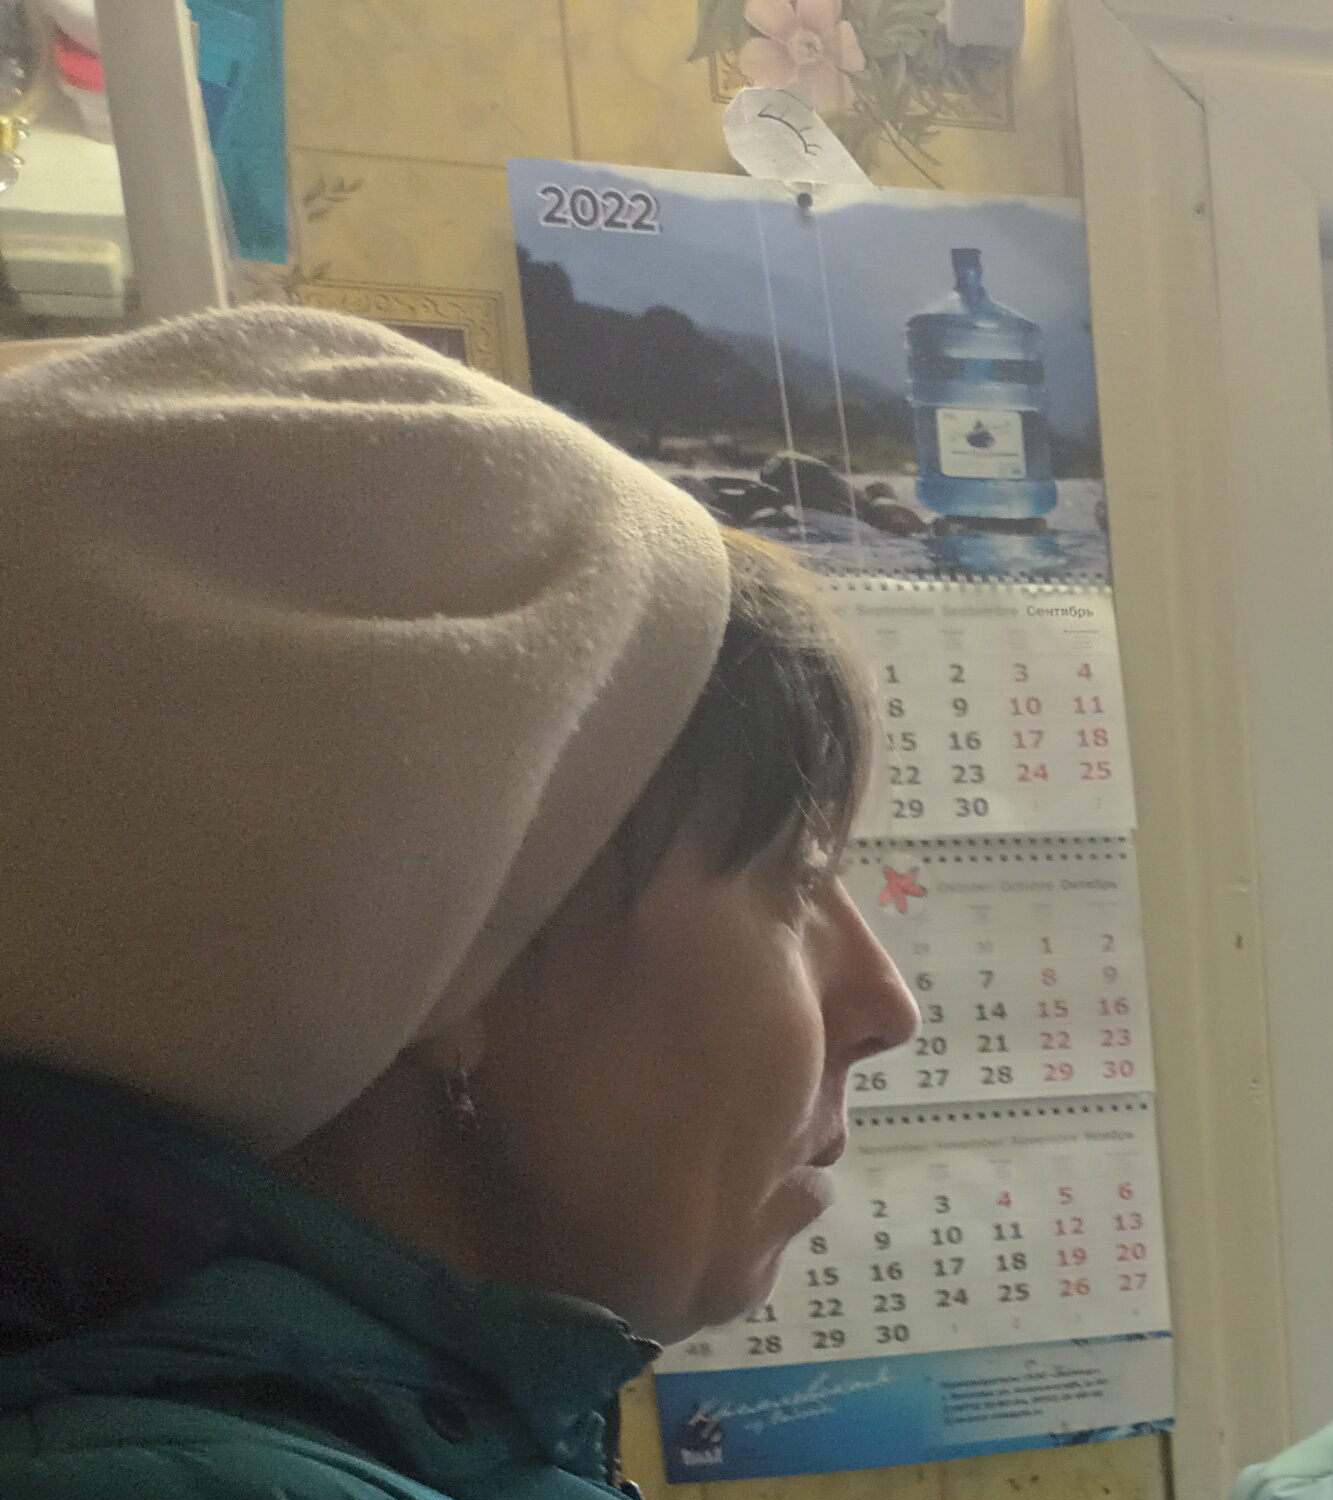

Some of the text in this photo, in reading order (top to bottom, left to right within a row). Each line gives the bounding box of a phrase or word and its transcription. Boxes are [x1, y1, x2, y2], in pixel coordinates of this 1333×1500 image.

[538, 184, 659, 232] 2022
[1026, 604, 1095, 618] Сентябрь
[885, 663, 1093, 684] 1 2 3 4
[888, 696, 1104, 718] 8 9 10 11
[949, 731, 982, 751] 16
[1014, 730, 1045, 749] 17
[1077, 728, 1109, 747] 18
[888, 760, 1112, 785] 22 23 24 25
[892, 798, 989, 818] 29 30
[1041, 936, 1053, 955] 1
[1102, 934, 1116, 953] 2
[916, 965, 1118, 991] 6 7 8 9
[974, 1002, 1007, 1021] 14
[1037, 999, 1069, 1019] 15
[1098, 997, 1130, 1016] 16
[915, 1028, 1132, 1056] 20 21 22 23
[853, 1059, 1135, 1091] 26 27 28 29 30
[872, 1182, 1133, 1218] 2 3 4 5 6
[810, 1211, 1143, 1255] 8 9 10 11 12 13
[806, 1242, 1147, 1287] 15 16 17 18 19 20
[808, 1297, 845, 1319] 22
[873, 1292, 907, 1313] 23
[934, 1287, 969, 1308] 24
[998, 1282, 1031, 1303] 25
[1059, 1277, 1091, 1298] 26
[1119, 1272, 1148, 1292] 27
[747, 1334, 783, 1355] 28
[811, 1328, 847, 1349] 29
[876, 1323, 910, 1344] 30
